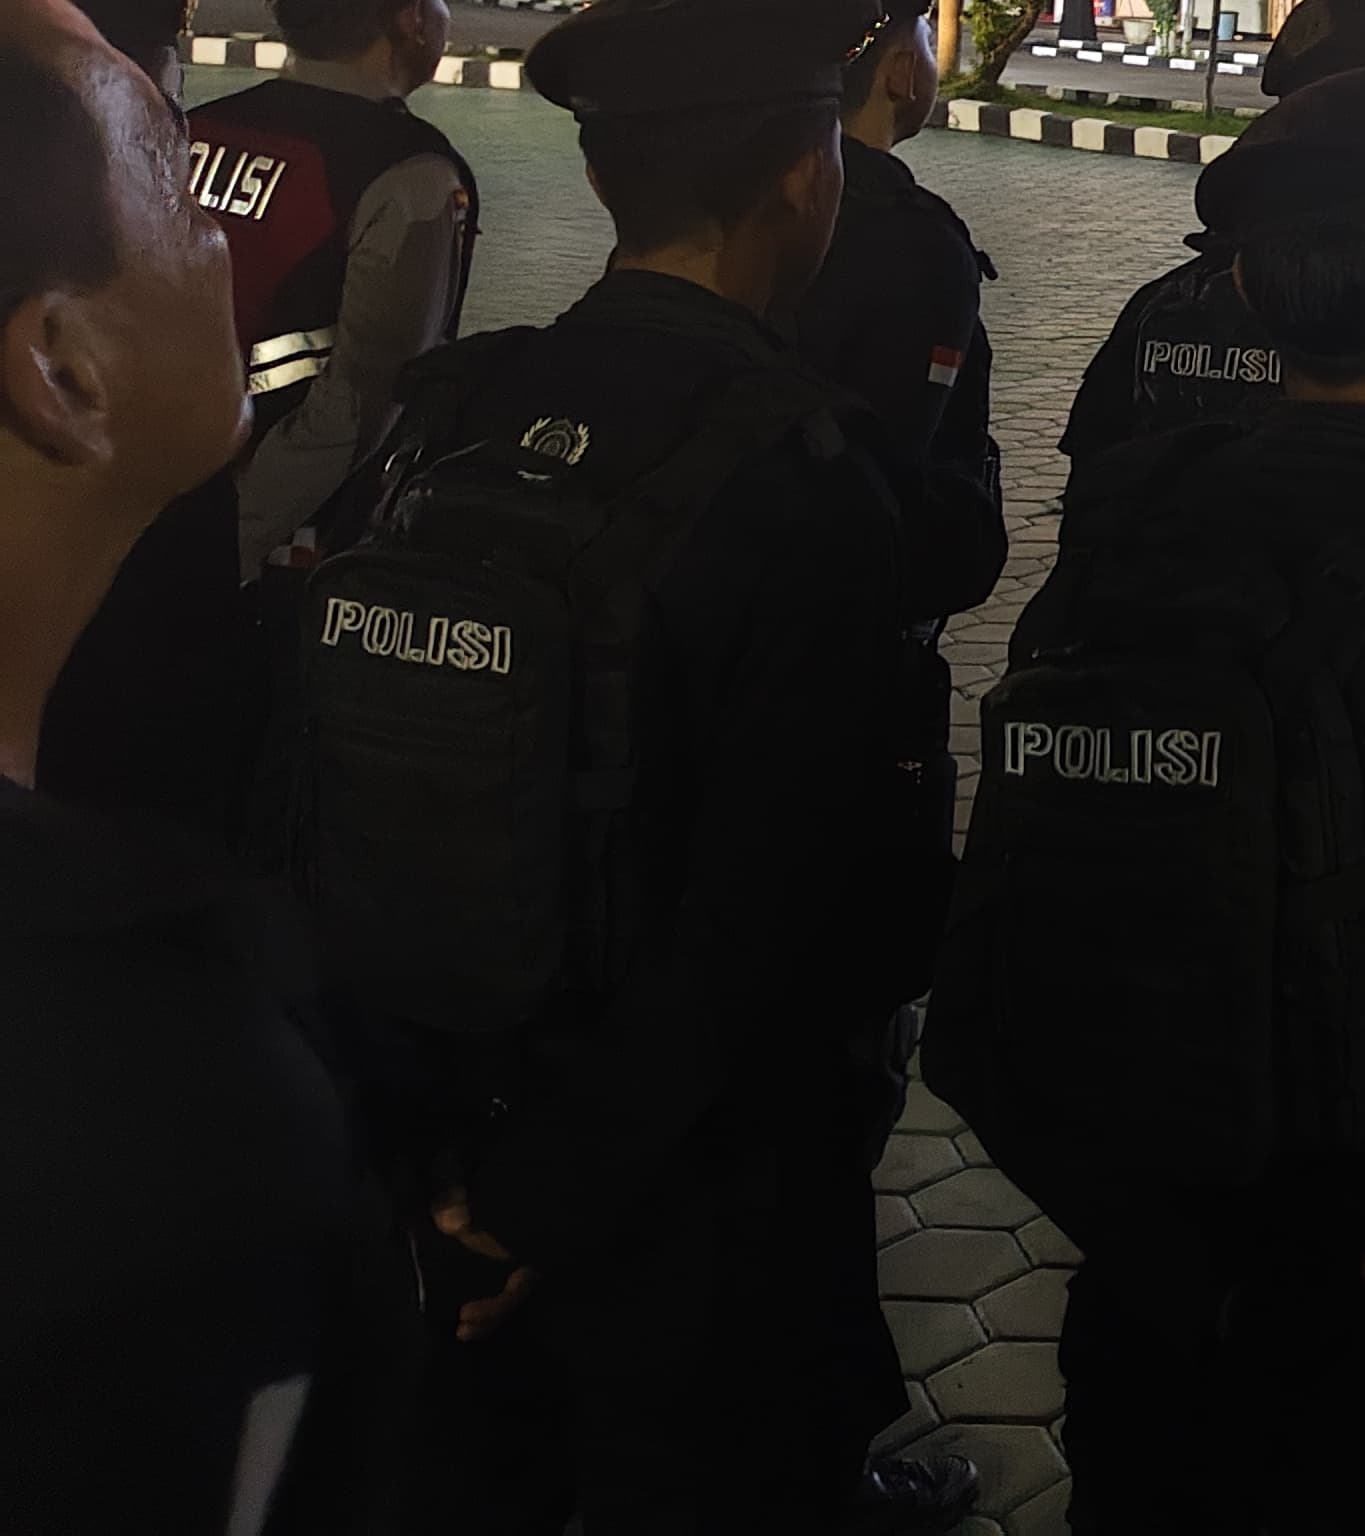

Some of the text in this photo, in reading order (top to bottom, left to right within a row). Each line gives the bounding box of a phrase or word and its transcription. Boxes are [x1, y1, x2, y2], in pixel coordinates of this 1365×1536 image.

[1143, 340, 1281, 385] POLISI
[319, 597, 512, 674] POLISI
[1004, 721, 1222, 787] POLISI
